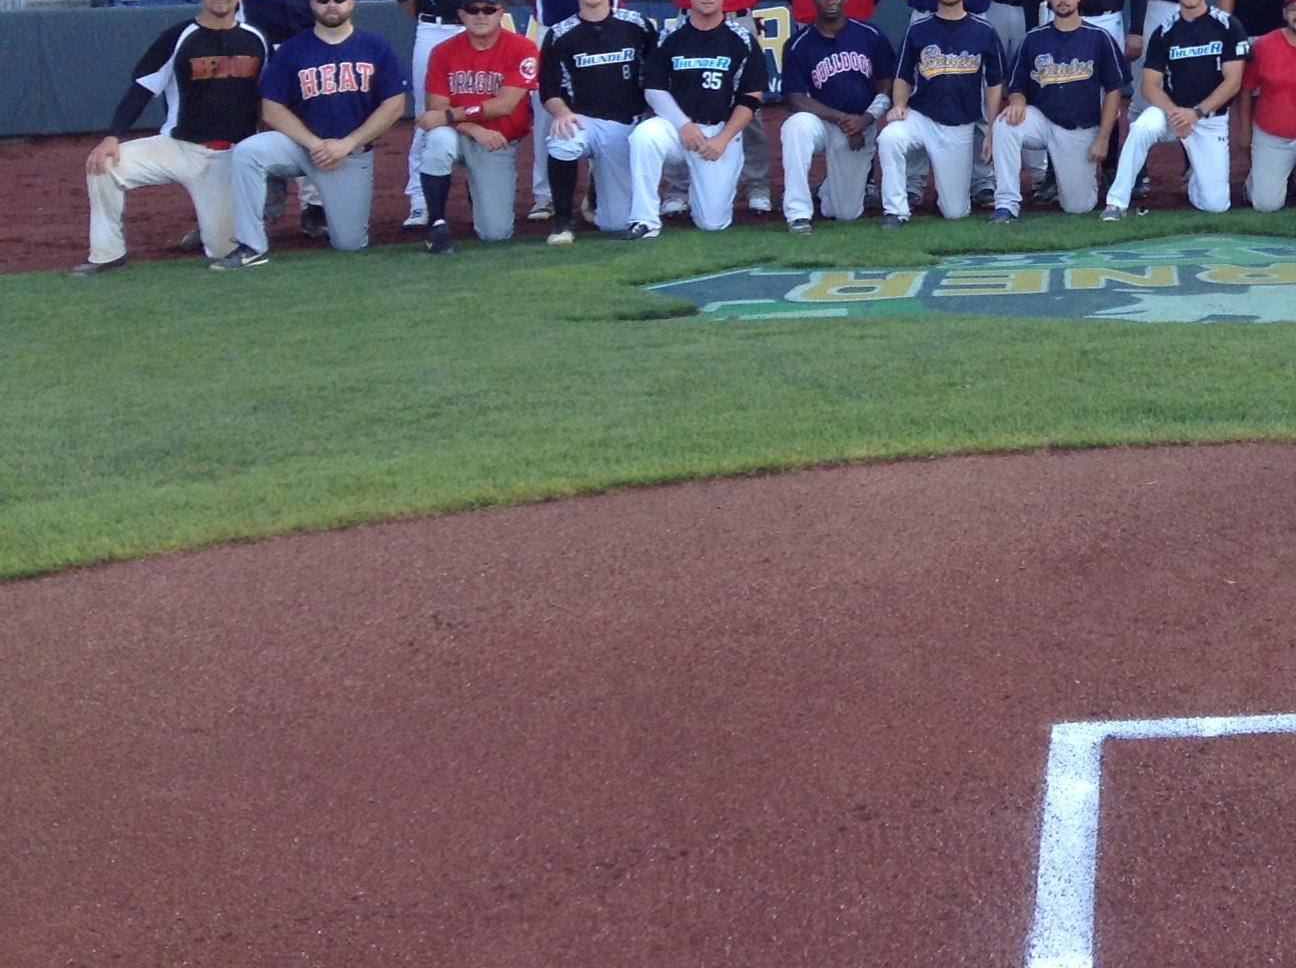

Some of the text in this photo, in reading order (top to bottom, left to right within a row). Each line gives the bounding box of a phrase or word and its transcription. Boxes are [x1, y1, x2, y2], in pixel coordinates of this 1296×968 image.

[622, 64, 632, 80] 8
[1215, 56, 1222, 71] 1
[297, 61, 375, 100] HEAT
[701, 71, 724, 90] 35
